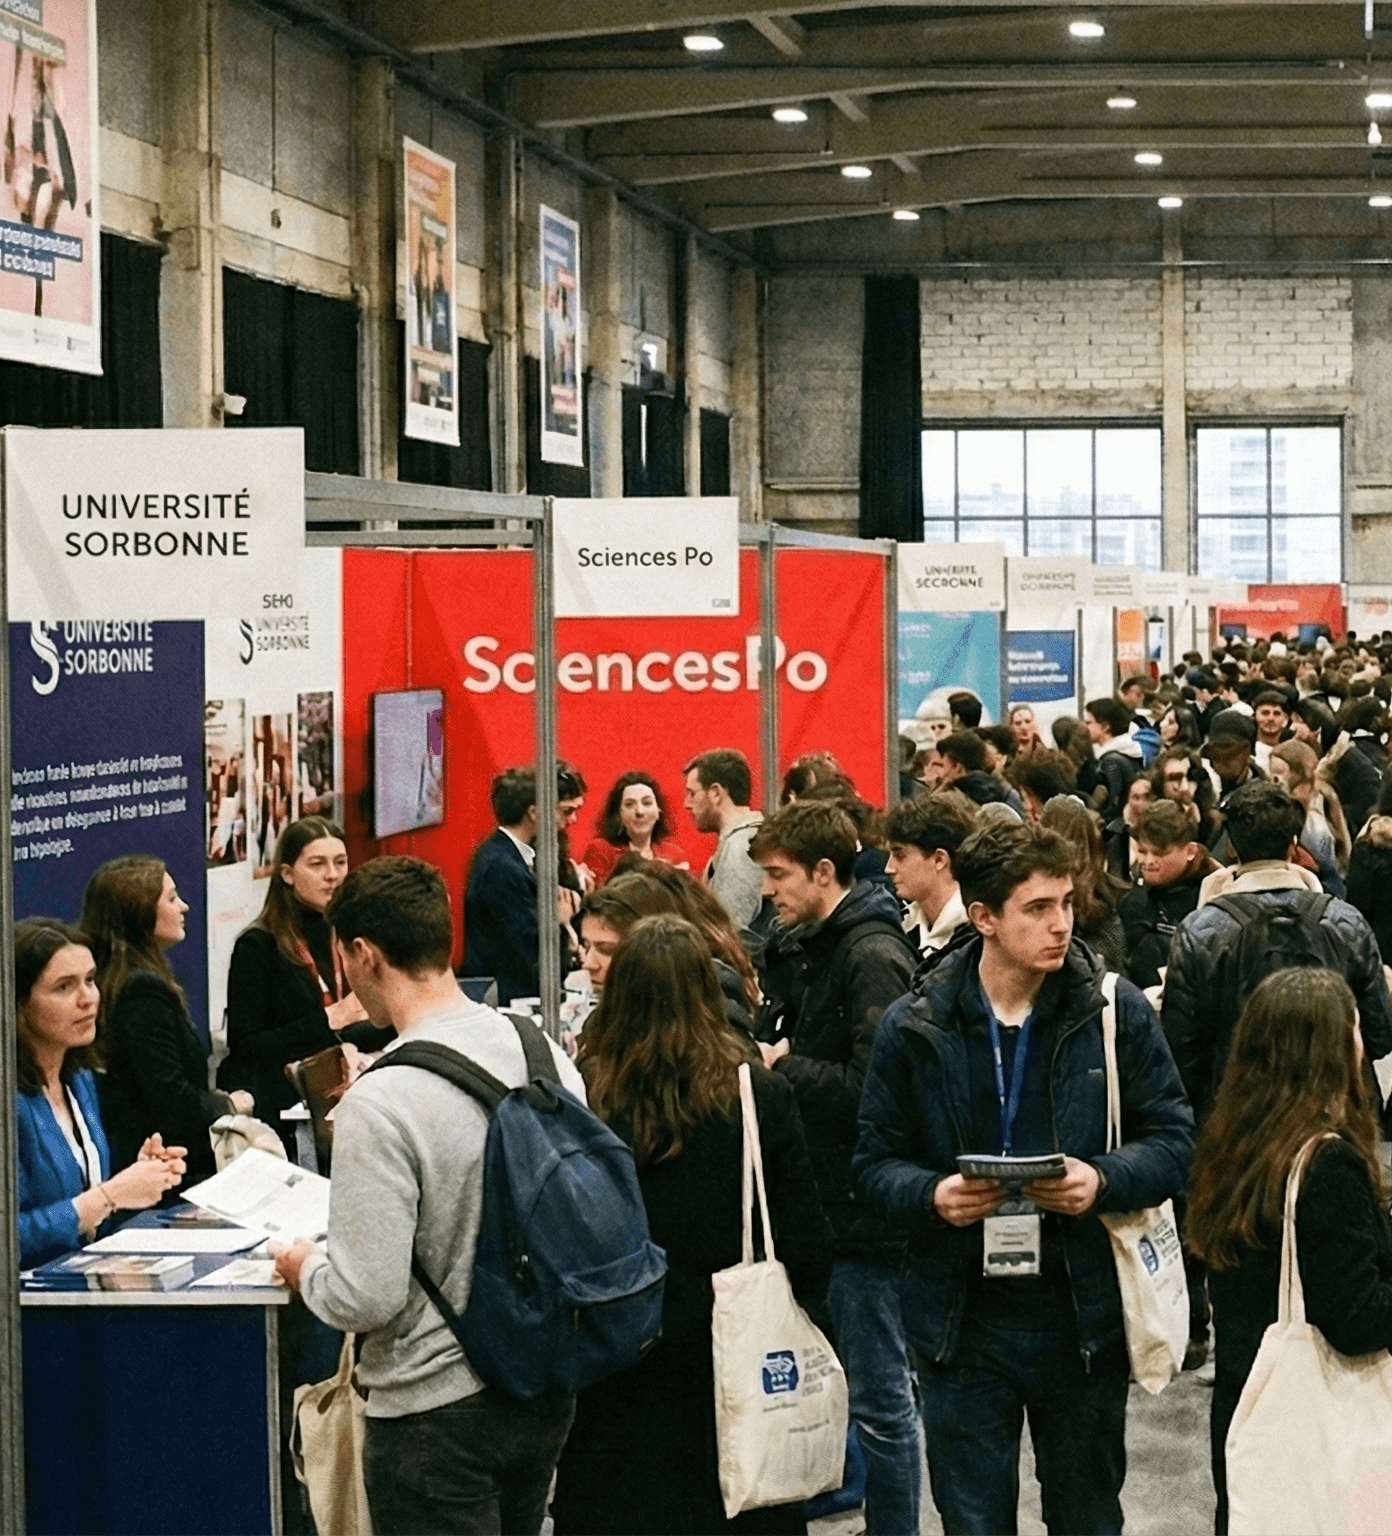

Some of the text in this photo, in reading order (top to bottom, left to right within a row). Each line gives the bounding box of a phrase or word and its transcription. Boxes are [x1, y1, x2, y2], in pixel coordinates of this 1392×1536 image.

[63, 488, 251, 520] UNIVERSITÉ
[65, 531, 249, 557] SORBONNE
[578, 546, 713, 567] Sciences Po
[64, 647, 154, 675] SORBONNE
[462, 634, 828, 694] ScencesPo
